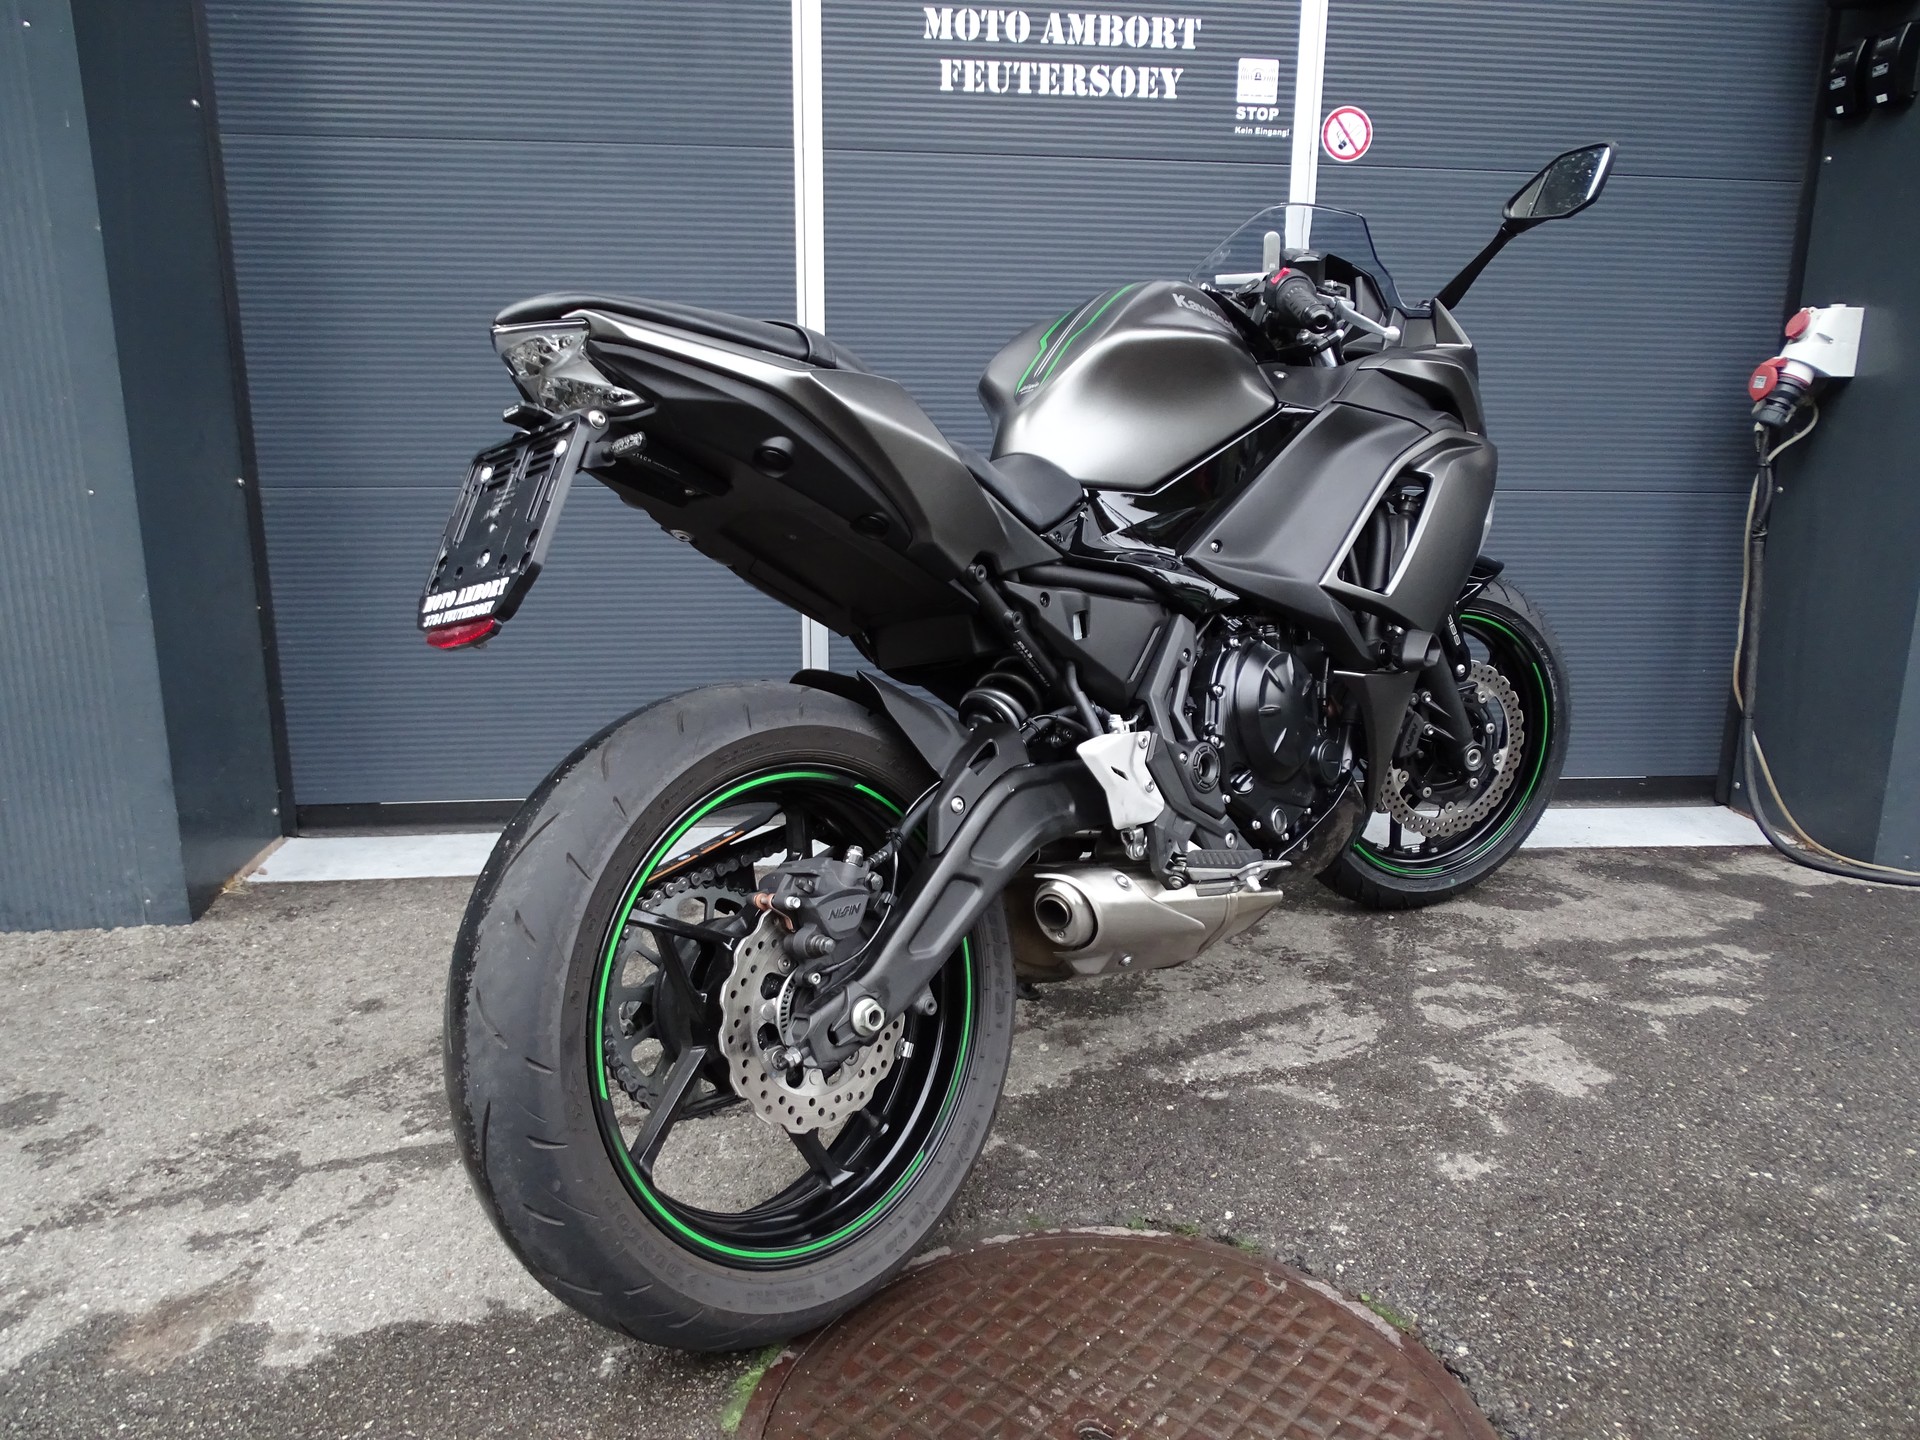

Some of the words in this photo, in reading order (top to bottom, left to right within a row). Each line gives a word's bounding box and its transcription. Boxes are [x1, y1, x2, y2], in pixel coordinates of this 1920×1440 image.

[923, 7, 1031, 43] MOTO
[1040, 12, 1202, 50] AMBORT
[940, 59, 1184, 99] FEUTERSOEY
[1235, 106, 1280, 121] STOP
[1234, 126, 1254, 135] Kein
[1255, 127, 1290, 138] Eingang!
[422, 590, 457, 614] MOTO
[455, 576, 510, 606] AMBORT
[1447, 613, 1461, 646] ABS
